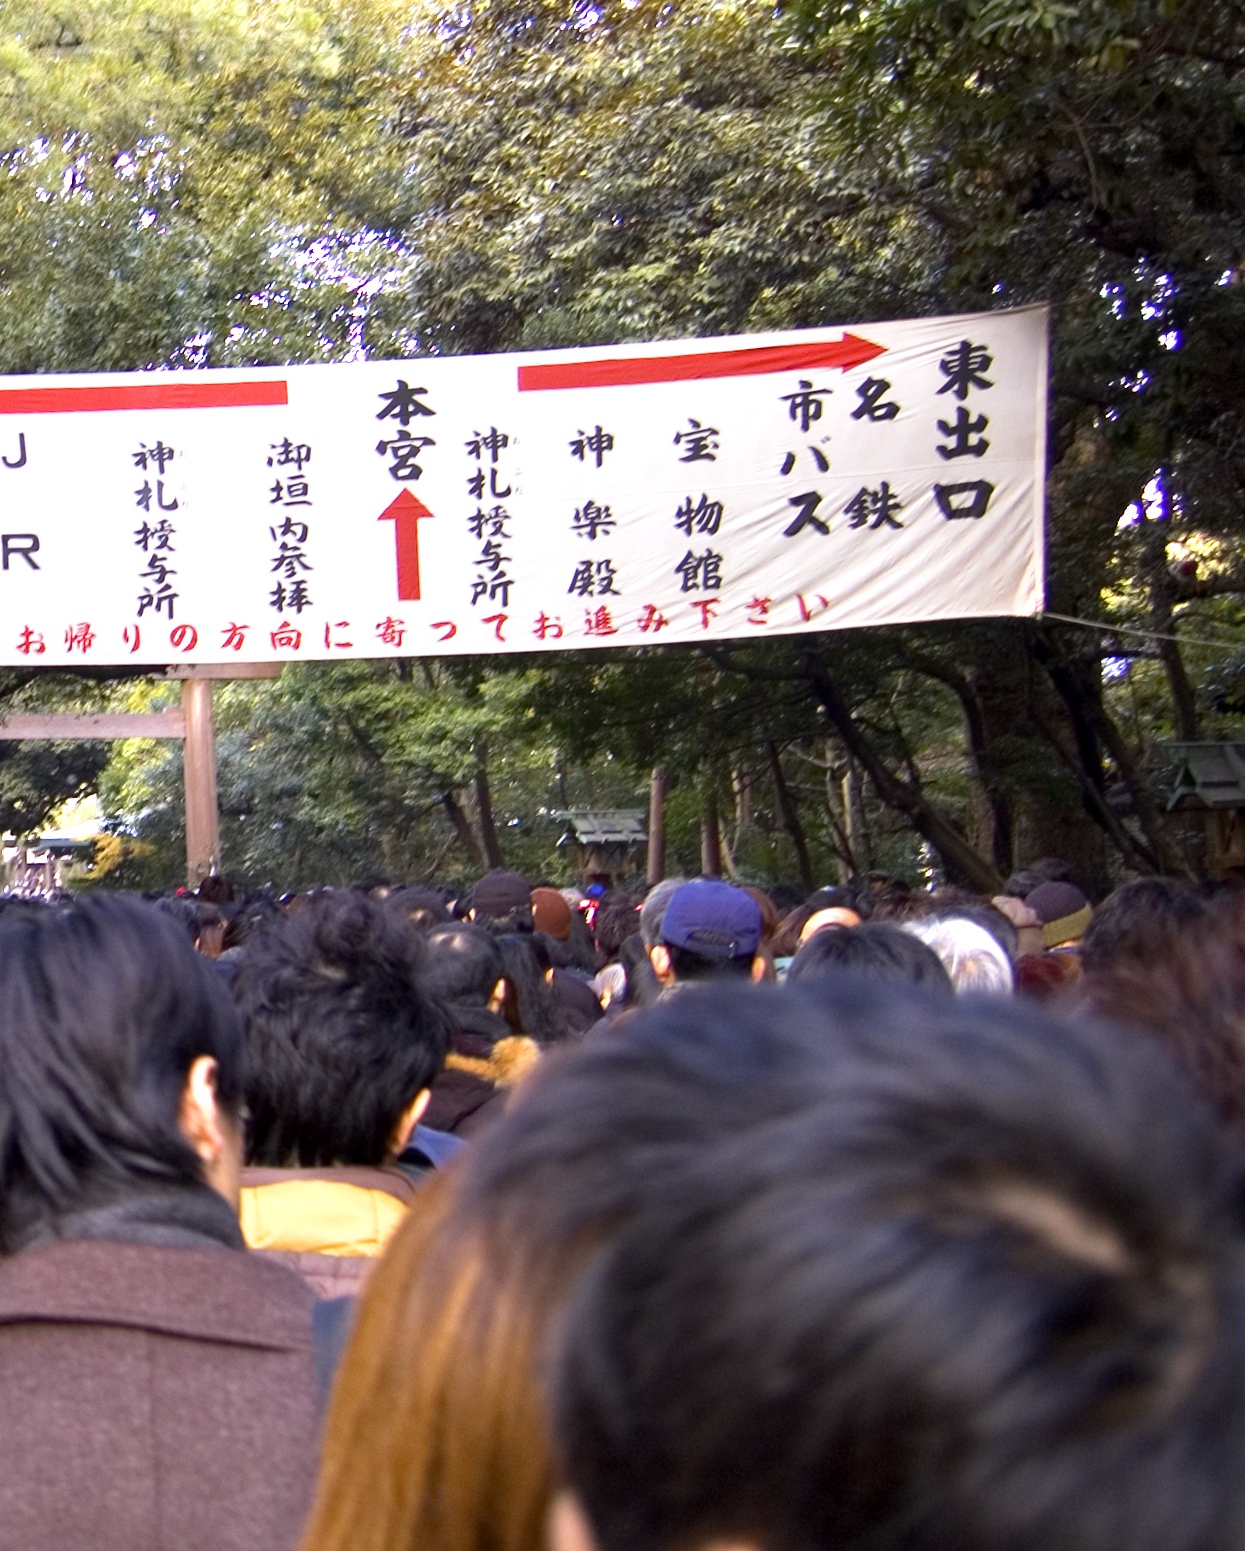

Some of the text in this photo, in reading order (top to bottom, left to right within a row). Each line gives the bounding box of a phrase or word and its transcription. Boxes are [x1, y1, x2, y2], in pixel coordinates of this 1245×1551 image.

[1, 432, 41, 570] JR
[377, 380, 437, 480] 本宮
[569, 425, 621, 596] 神楽殿
[673, 418, 724, 592] 宝物館
[780, 380, 834, 538] 市バス
[843, 377, 904, 530] 名鉄
[933, 340, 995, 521] 東出口
[133, 440, 180, 620] 神札授与所
[266, 438, 313, 614] 御垣内参拝
[464, 426, 515, 608] 神札授与所
[17, 594, 829, 655] お帰りの方向に寄ってお進み下さい
